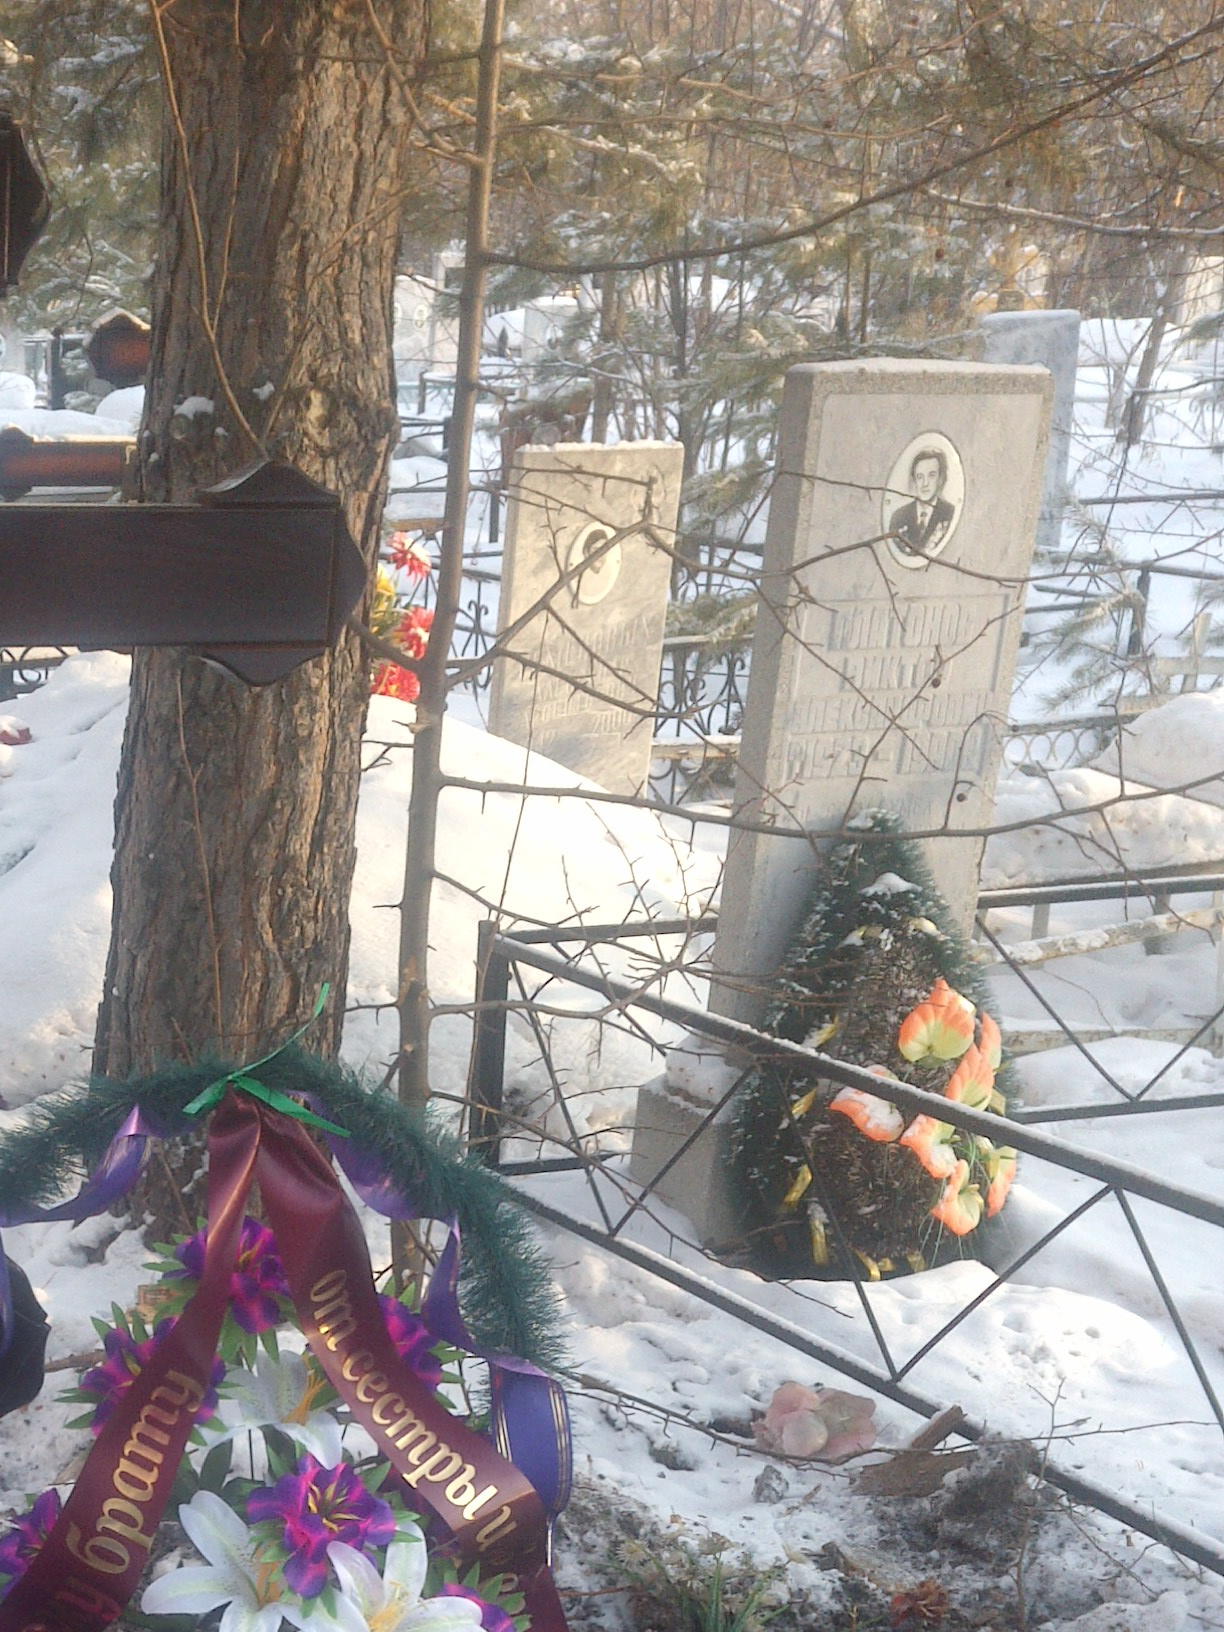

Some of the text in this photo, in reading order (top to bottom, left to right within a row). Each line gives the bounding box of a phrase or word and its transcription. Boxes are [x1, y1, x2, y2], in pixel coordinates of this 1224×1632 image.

[65, 1369, 205, 1575] брату
[309, 1268, 357, 1352] от
[341, 1349, 499, 1521] сестры
